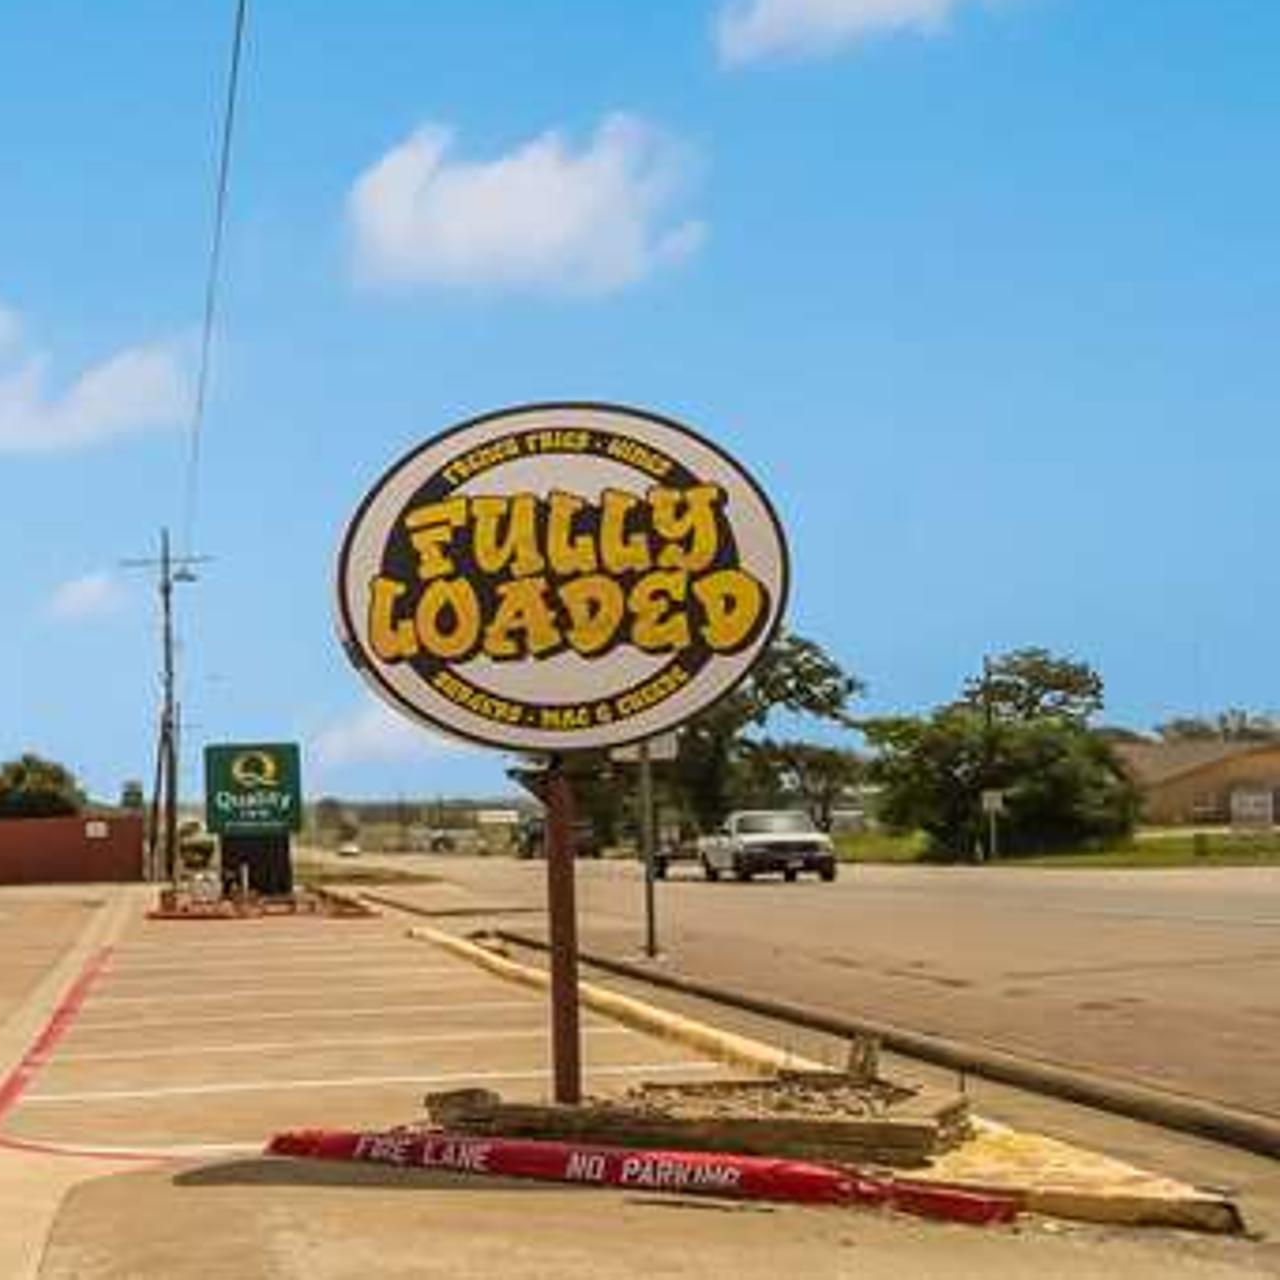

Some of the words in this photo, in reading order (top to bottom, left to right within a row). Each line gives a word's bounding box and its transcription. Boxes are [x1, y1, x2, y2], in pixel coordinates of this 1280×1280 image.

[404, 483, 726, 580] FULLY
[368, 567, 766, 660] LOADED
[216, 790, 292, 812] Quality
[352, 1136, 410, 1163] FIRE
[422, 1140, 492, 1171] LANE
[566, 1152, 607, 1180] NO
[621, 1155, 742, 1186] PARKING
